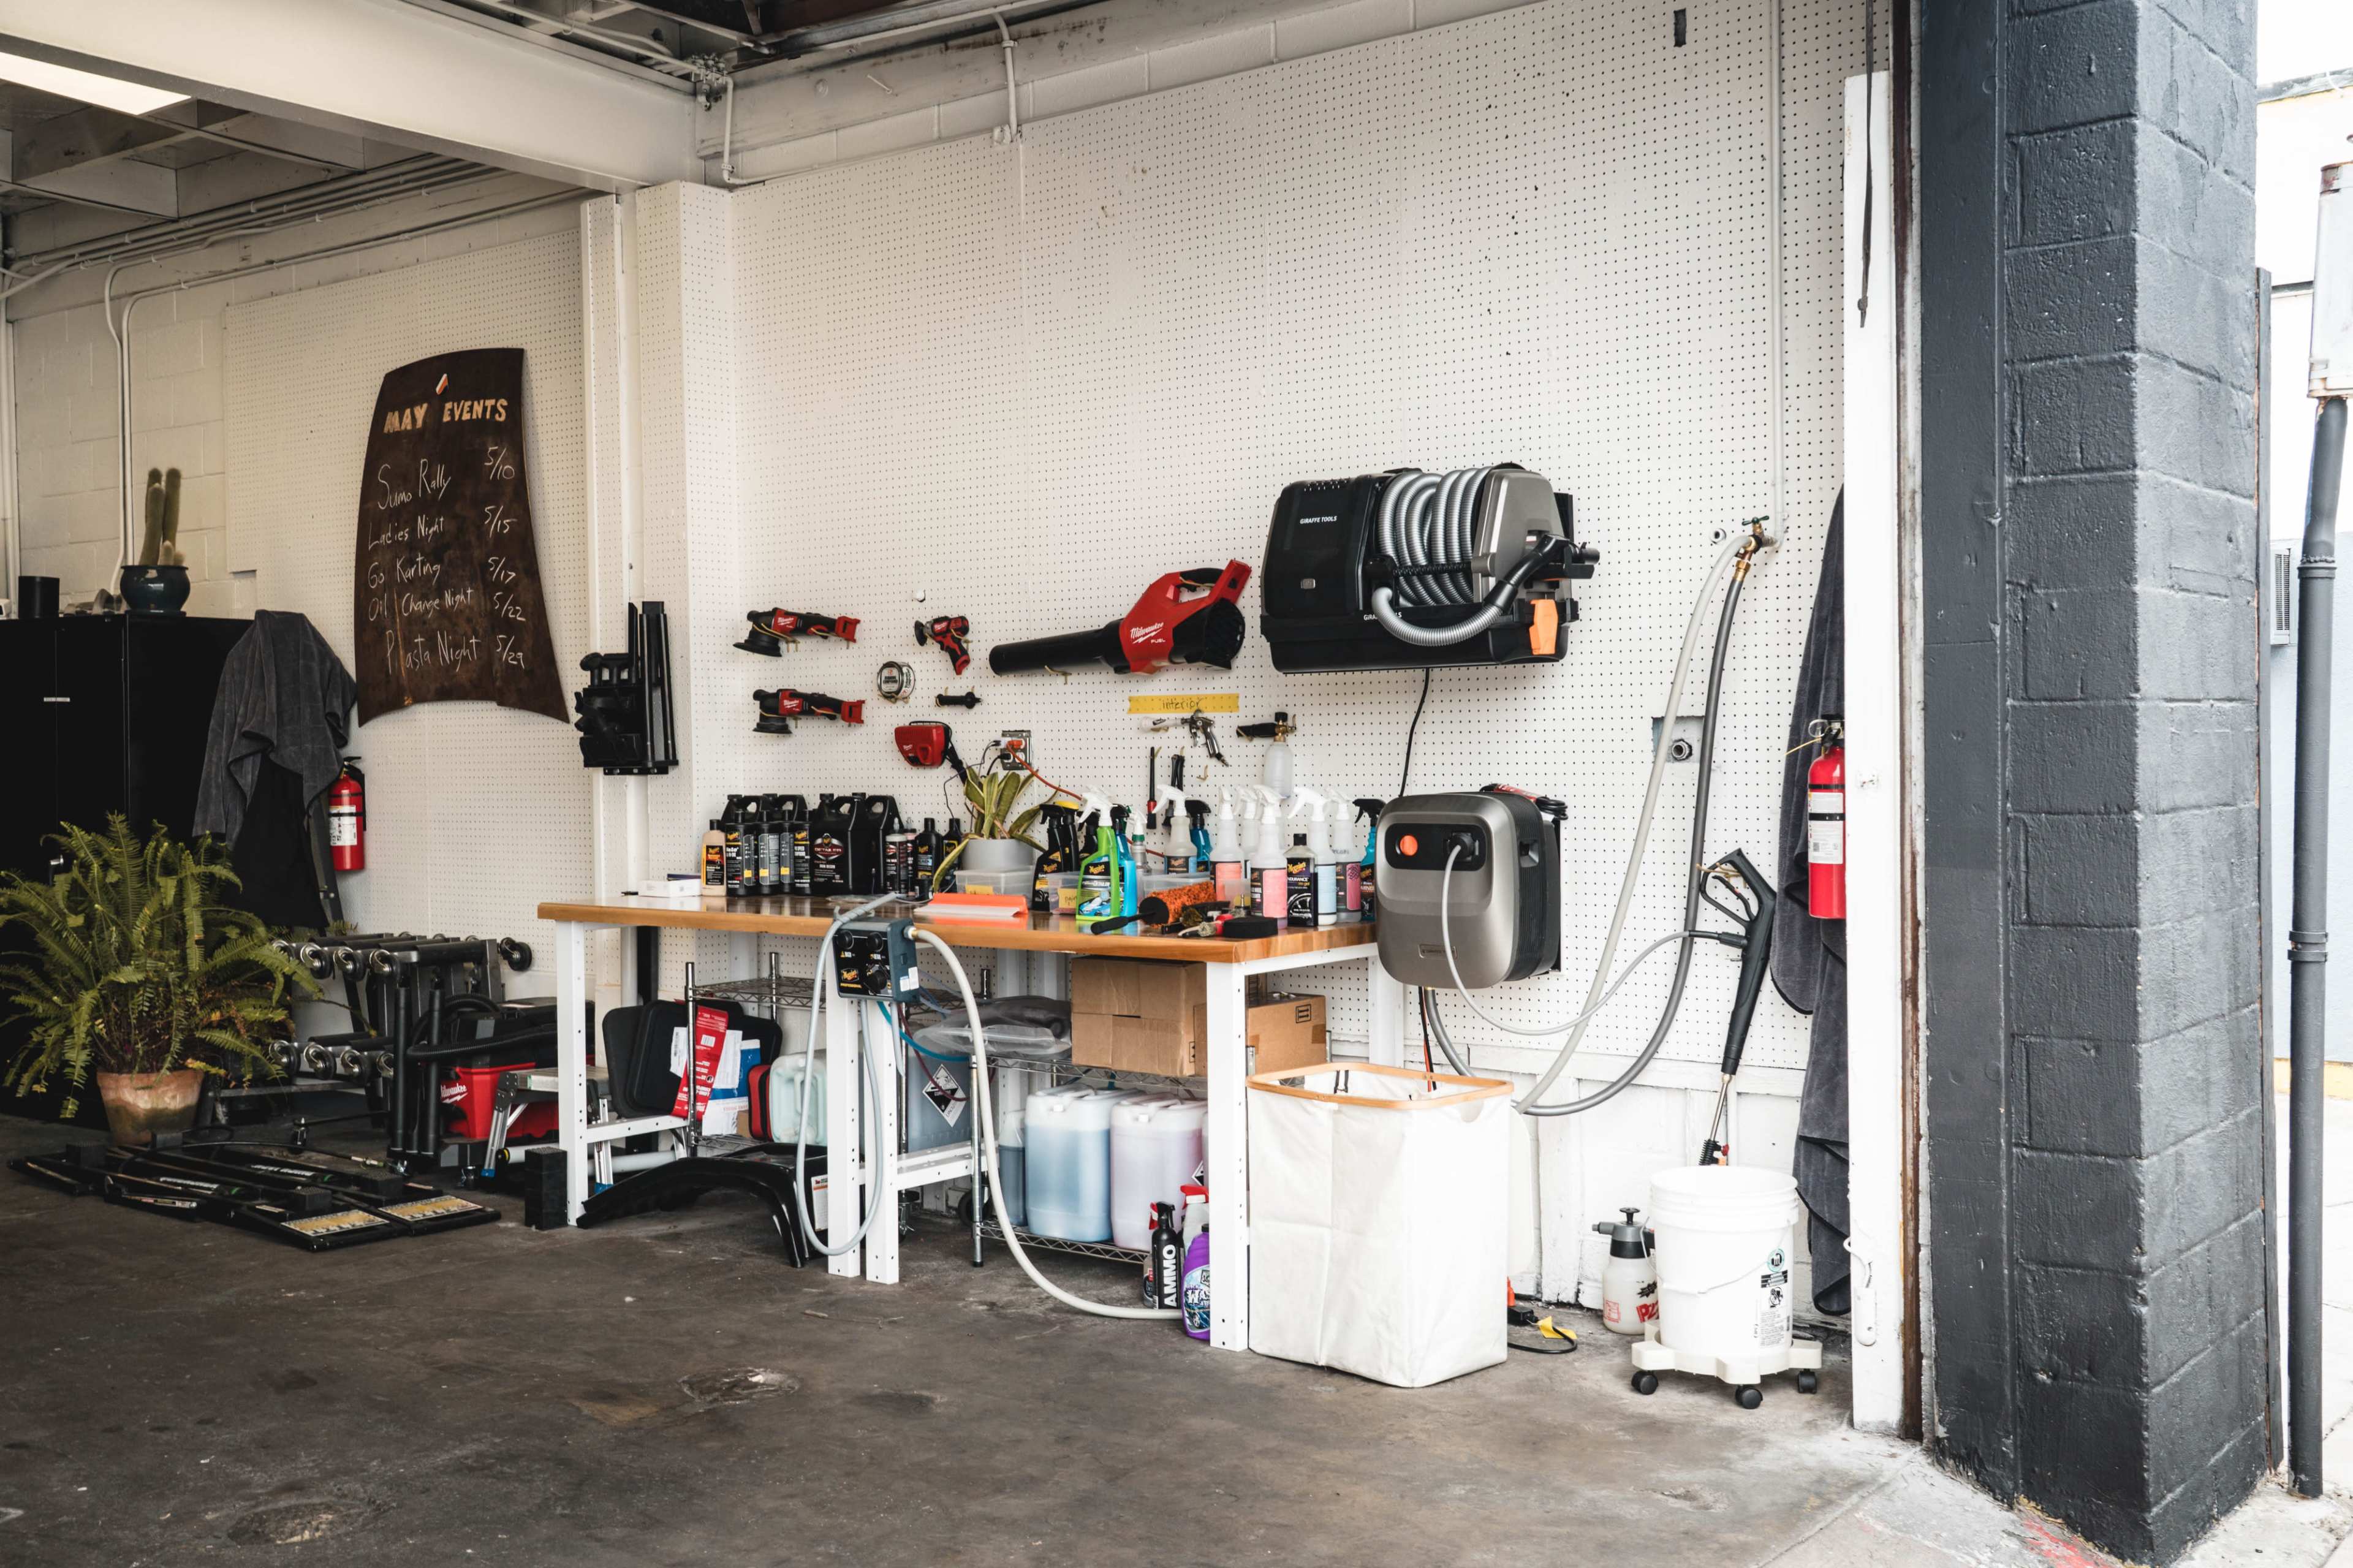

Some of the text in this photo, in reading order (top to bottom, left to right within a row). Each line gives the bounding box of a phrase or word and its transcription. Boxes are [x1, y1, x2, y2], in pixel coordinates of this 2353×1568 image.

[384, 398, 509, 434] MAY EVENTS
[377, 445, 515, 510] Sumo Rally 5/10
[368, 505, 518, 551] Ladies Night 5/15
[368, 552, 517, 589] Go Karting 5/17
[368, 586, 526, 621] Oil Change Night 5/22
[1130, 622, 1164, 639] Milwaukee
[438, 630, 482, 673] Night
[496, 635, 526, 670] 5/29
[1162, 697, 1204, 711] interior
[441, 1083, 467, 1098] ilwaukee
[1162, 1244, 1177, 1307] AMMO
